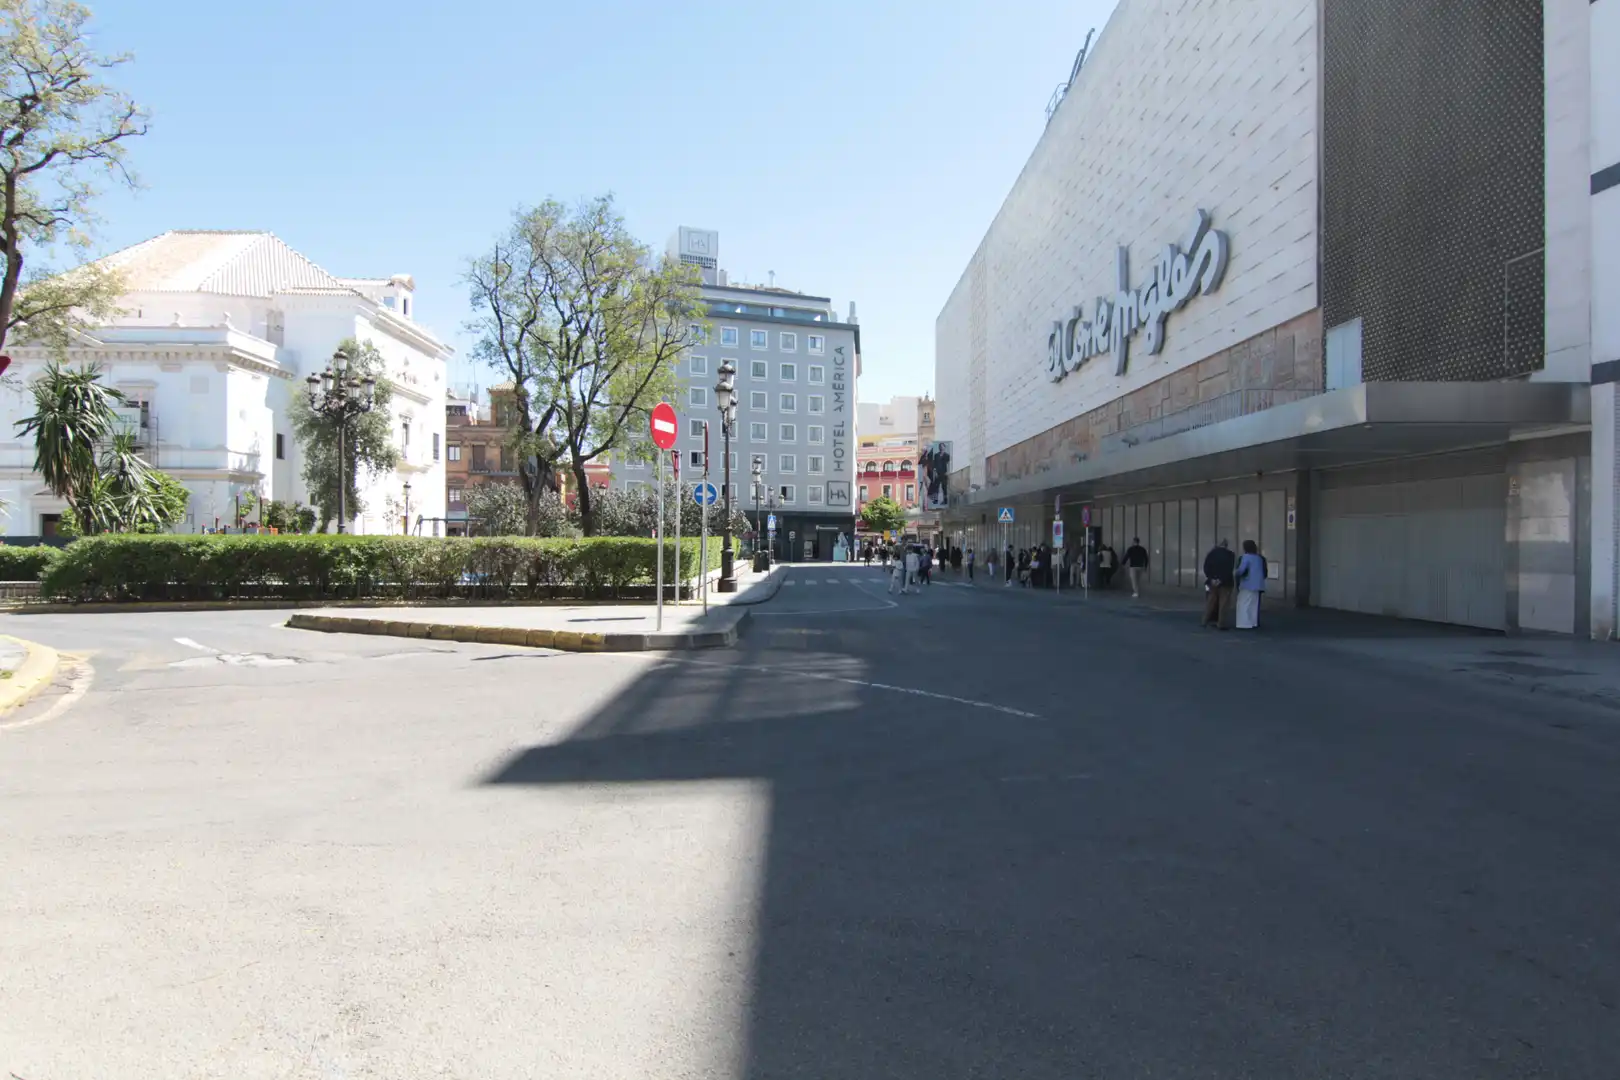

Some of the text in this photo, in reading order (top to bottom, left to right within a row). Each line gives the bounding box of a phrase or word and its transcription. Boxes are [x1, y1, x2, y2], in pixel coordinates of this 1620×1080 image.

[1062, 296, 1113, 376] Corte
[833, 420, 845, 472] HOTEL
[830, 489, 848, 500] HA
